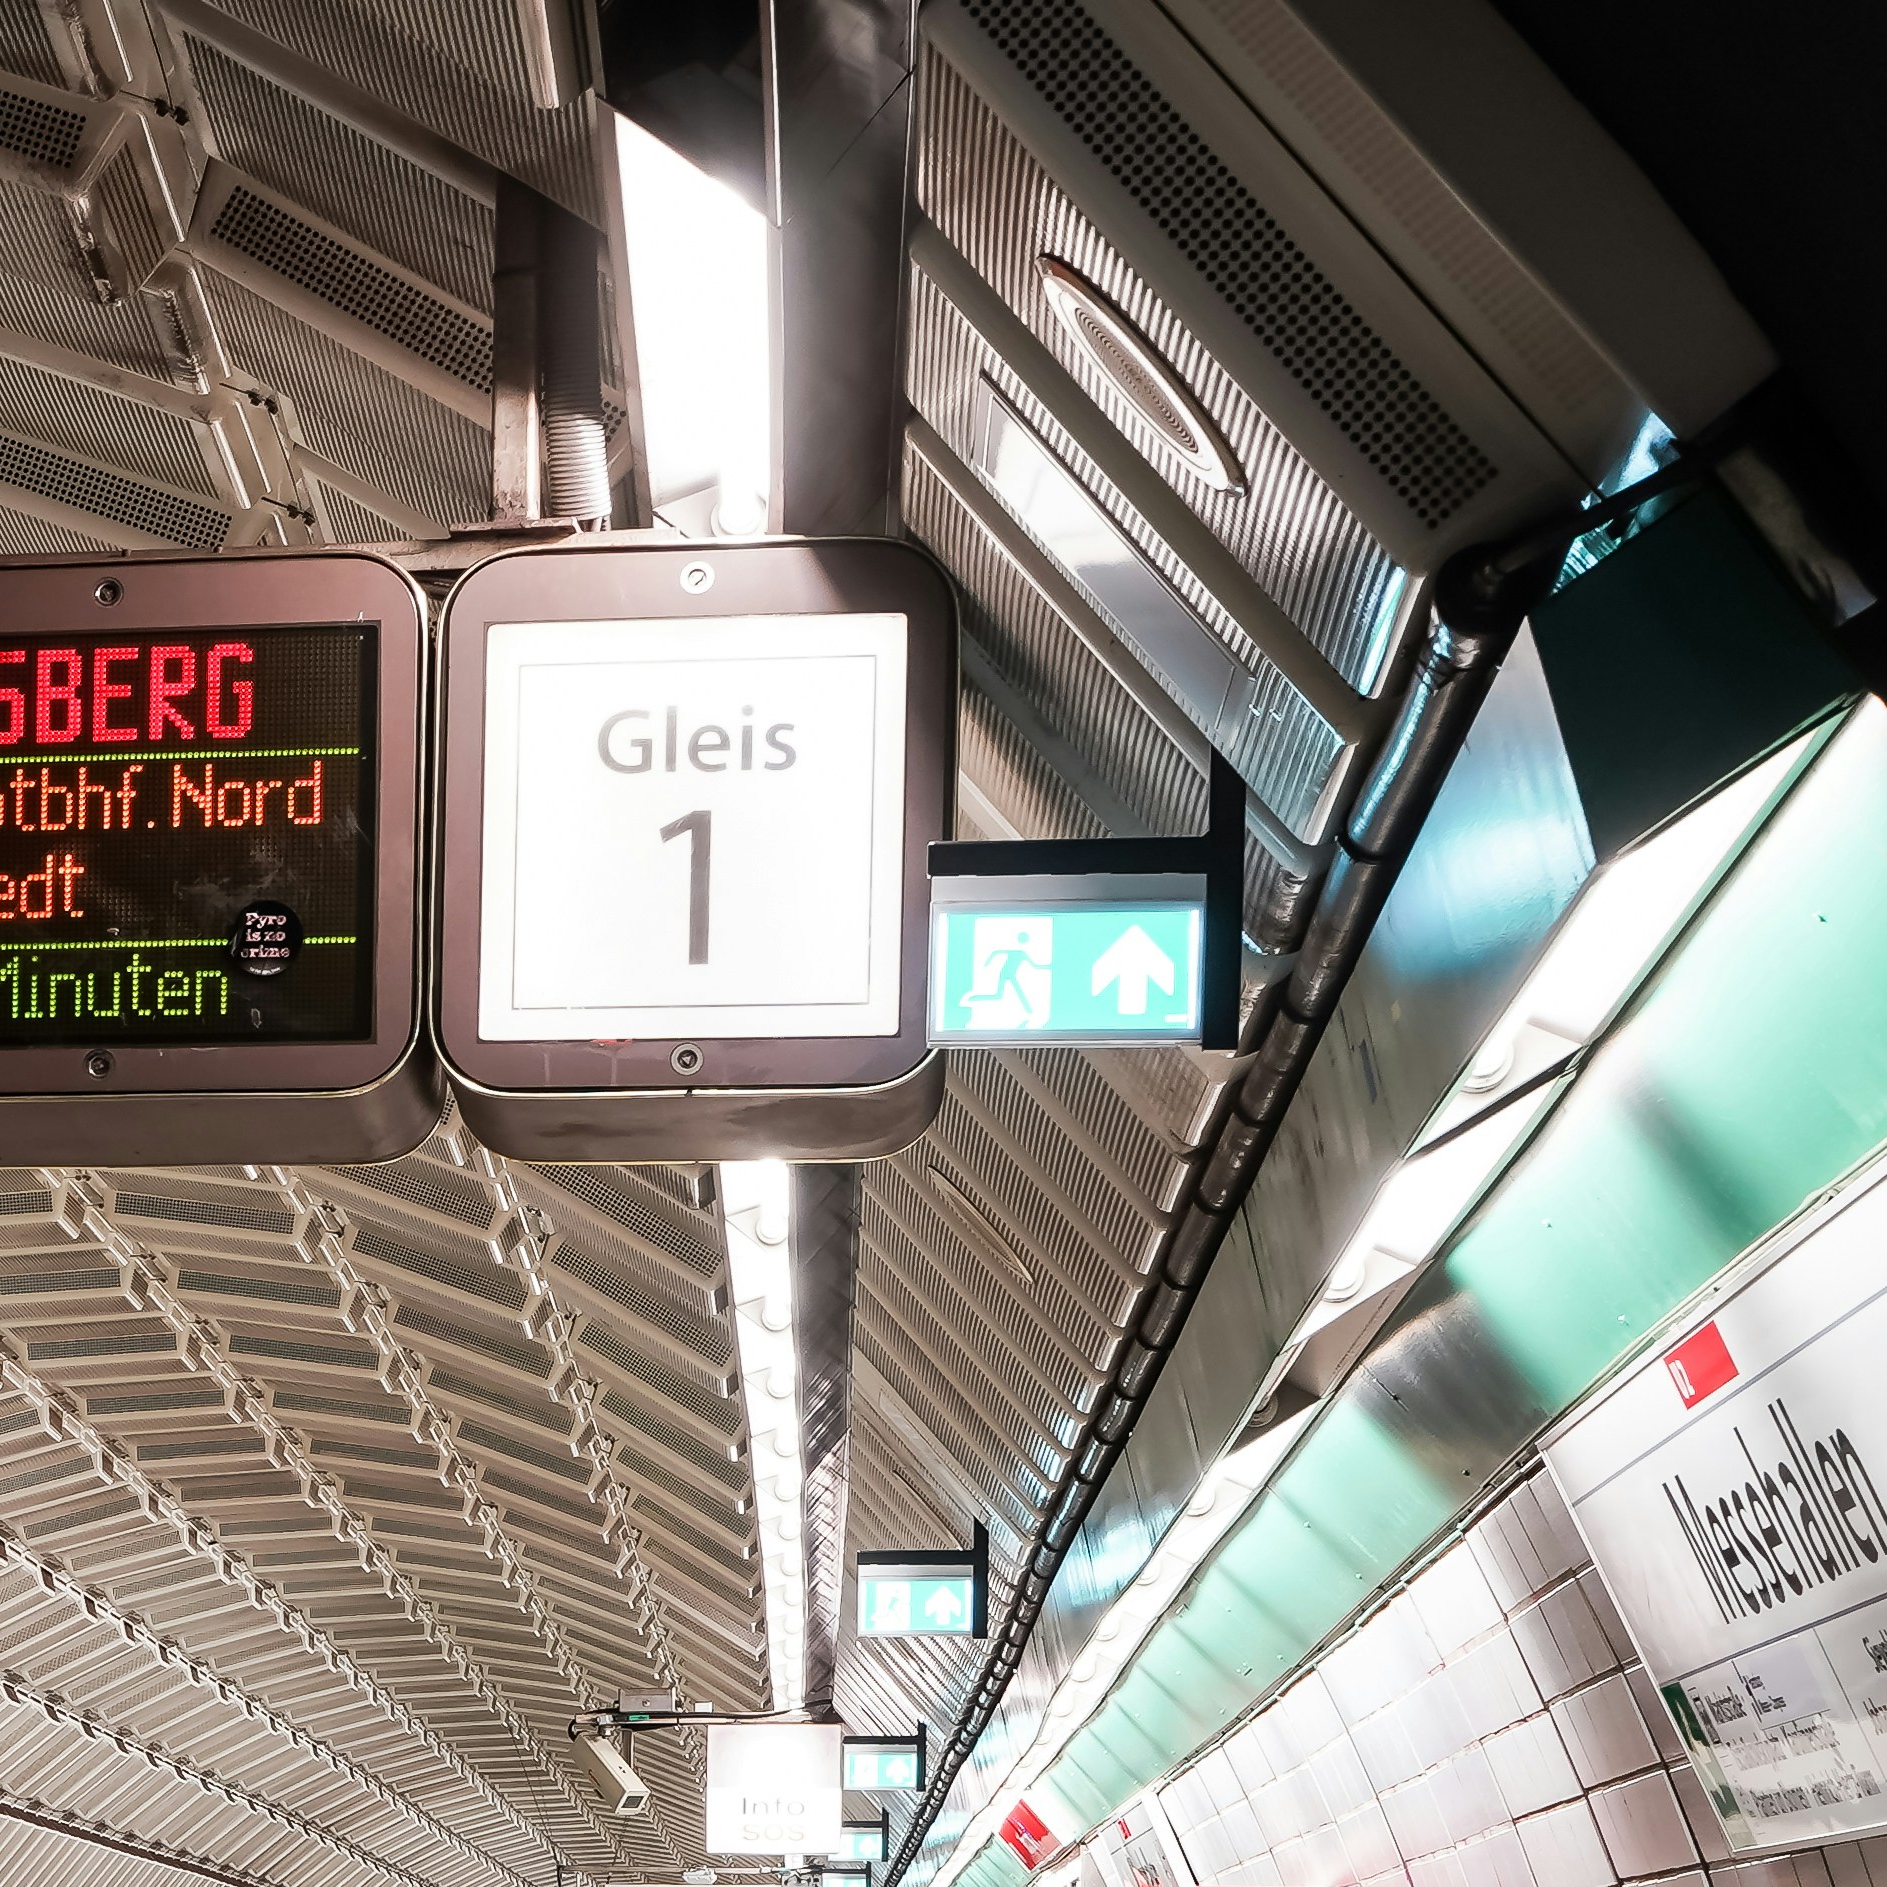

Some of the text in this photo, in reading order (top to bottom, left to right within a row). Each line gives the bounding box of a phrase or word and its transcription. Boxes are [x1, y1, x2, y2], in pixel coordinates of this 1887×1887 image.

[596, 704, 797, 774] Gleis
[658, 808, 714, 966] 1
[245, 912, 287, 929] Pyro
[246, 928, 286, 942] is no
[742, 1797, 805, 1816] Info
[742, 1823, 805, 1842] SOS
